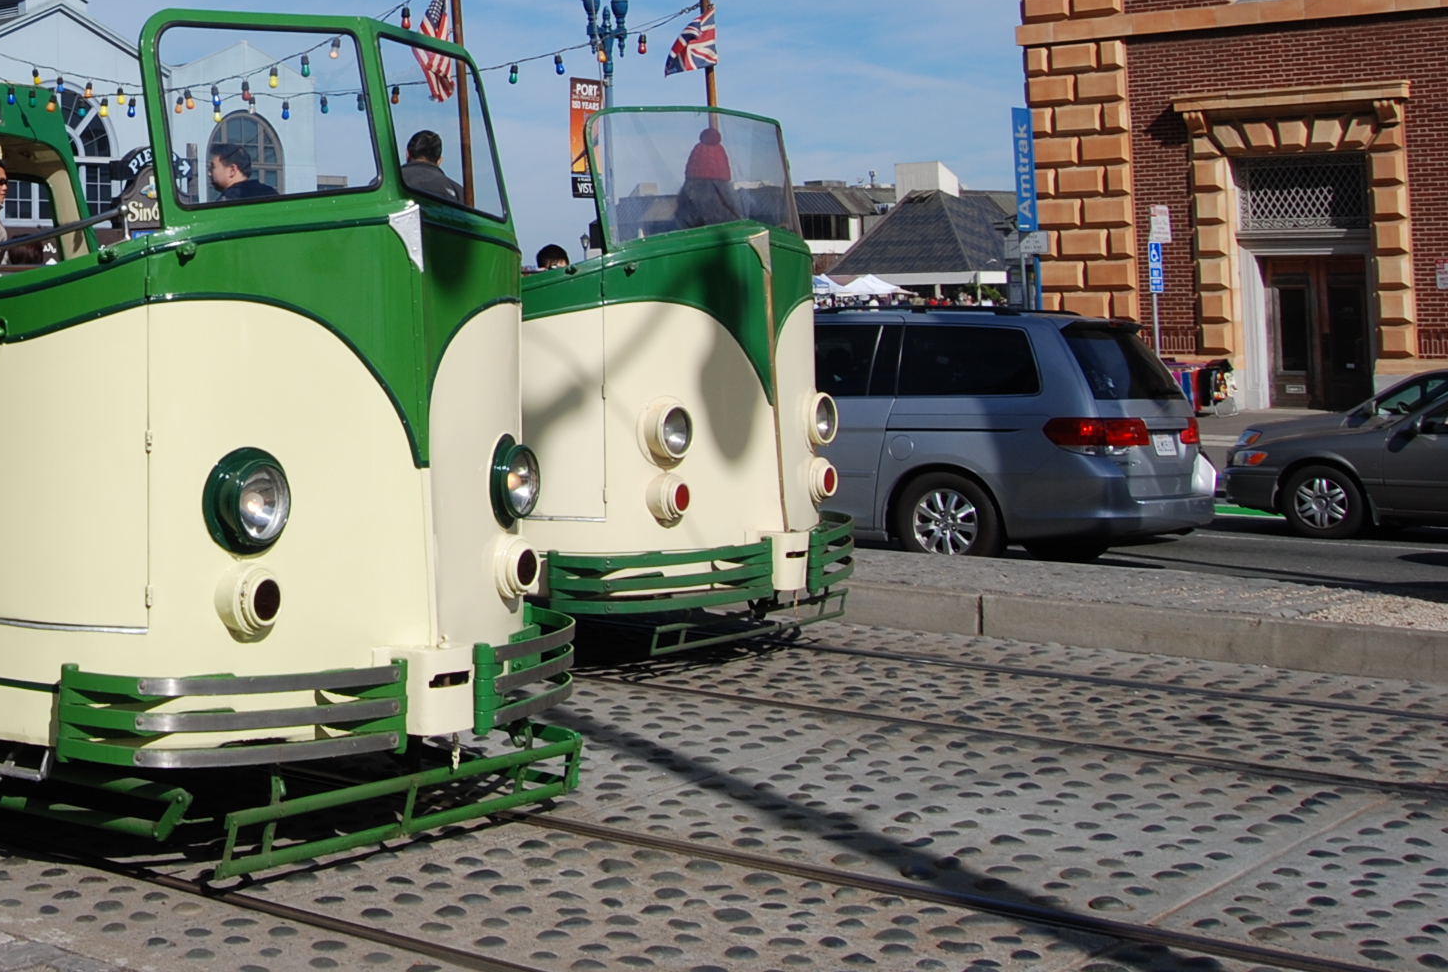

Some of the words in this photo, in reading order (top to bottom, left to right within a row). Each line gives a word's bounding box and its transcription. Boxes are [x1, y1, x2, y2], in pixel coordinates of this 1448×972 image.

[576, 83, 598, 96] PORT
[582, 101, 600, 111] YEARS
[128, 149, 152, 175] PIE
[1015, 123, 1032, 218] Amtrak
[577, 183, 594, 194] VIST
